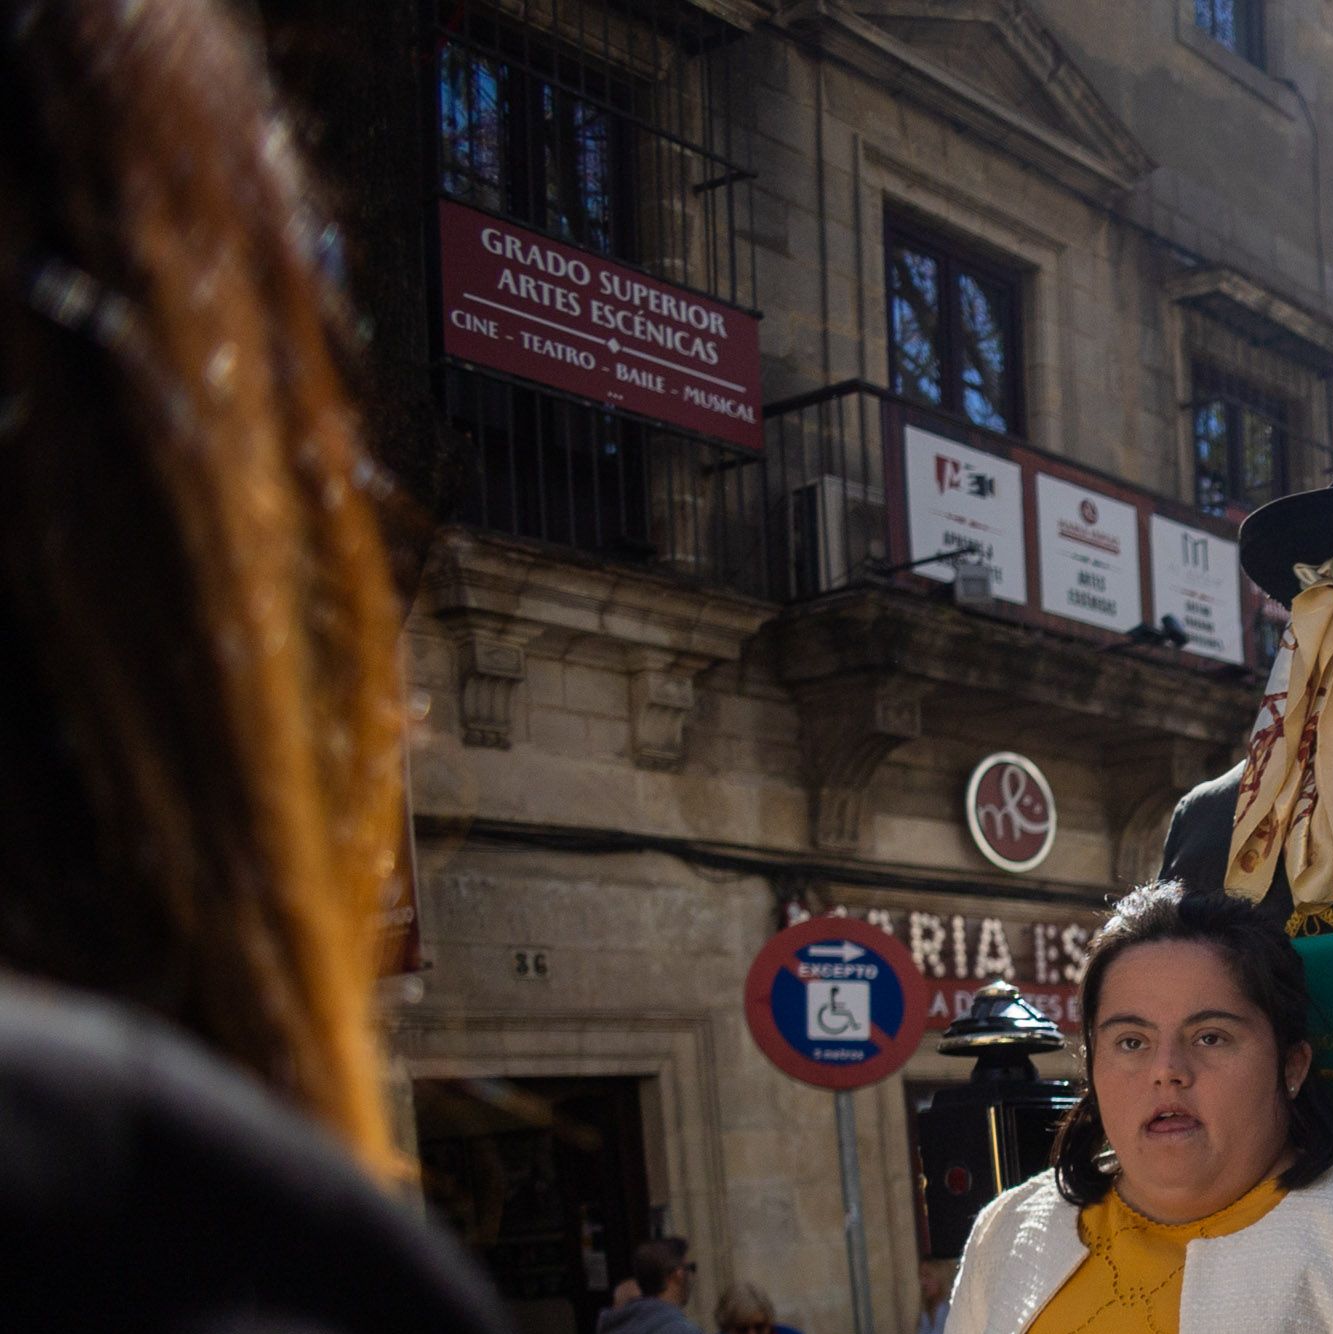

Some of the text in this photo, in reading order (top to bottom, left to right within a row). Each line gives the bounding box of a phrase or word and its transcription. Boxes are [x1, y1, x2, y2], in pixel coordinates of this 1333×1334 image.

[481, 227, 728, 339] GRADO SUPERIOR
[497, 267, 720, 366] ARTES ESCÉNICAS
[451, 309, 499, 340] CINE
[520, 331, 597, 370] TEATRO
[615, 363, 666, 394] BAILE
[684, 385, 757, 424] MUSICAL
[798, 963, 879, 980] EXCEPTO
